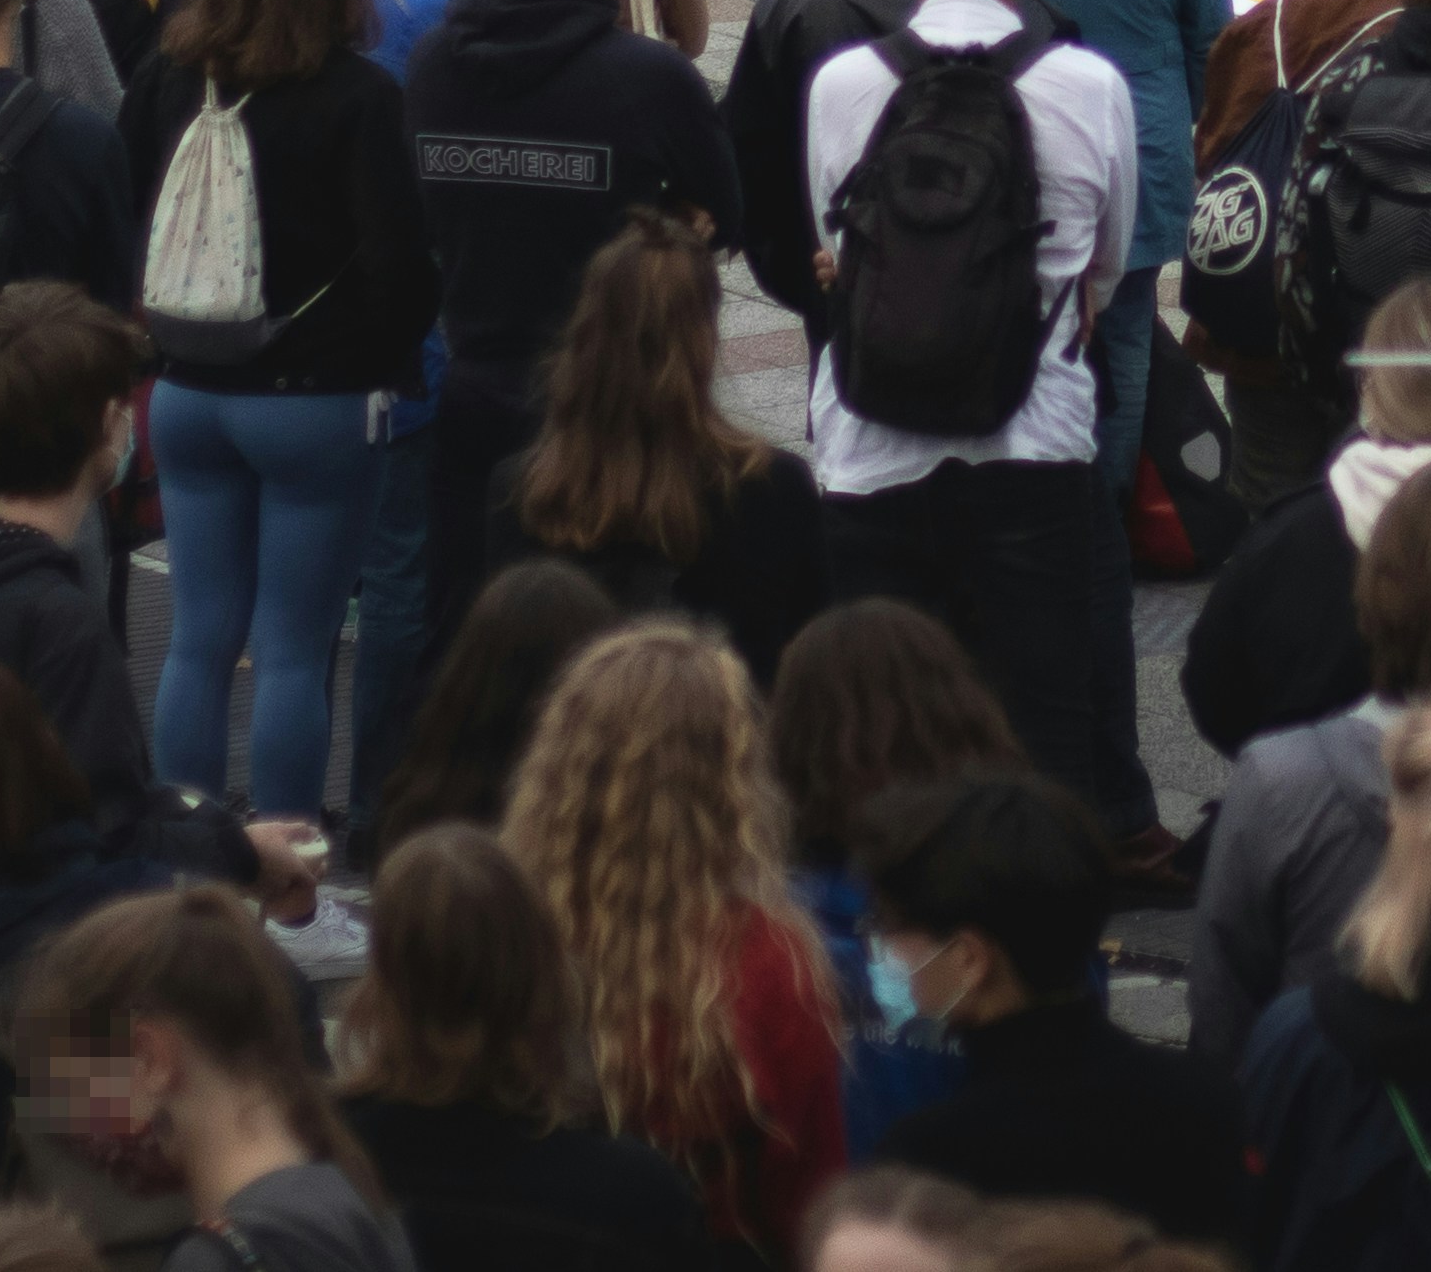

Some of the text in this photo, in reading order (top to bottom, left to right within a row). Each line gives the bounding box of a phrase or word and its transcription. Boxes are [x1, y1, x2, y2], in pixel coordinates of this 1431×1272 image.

[423, 145, 595, 182] KOCHEREI
[1191, 182, 1244, 222] ZIG
[1189, 214, 1257, 260] ZAG
